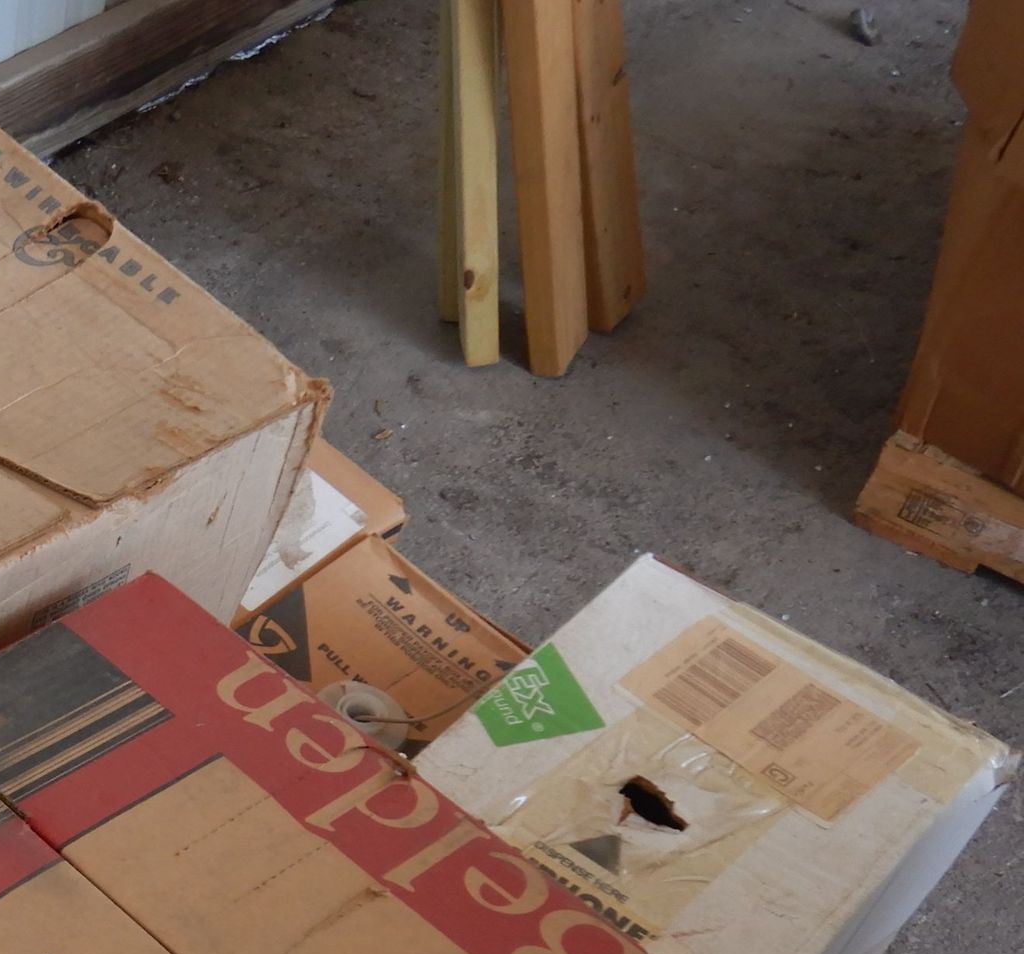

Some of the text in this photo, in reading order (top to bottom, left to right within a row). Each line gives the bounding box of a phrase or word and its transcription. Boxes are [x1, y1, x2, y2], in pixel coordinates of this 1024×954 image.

[386, 596, 492, 682] WARNING
[445, 612, 470, 633] UP
[318, 642, 352, 676] PULL
